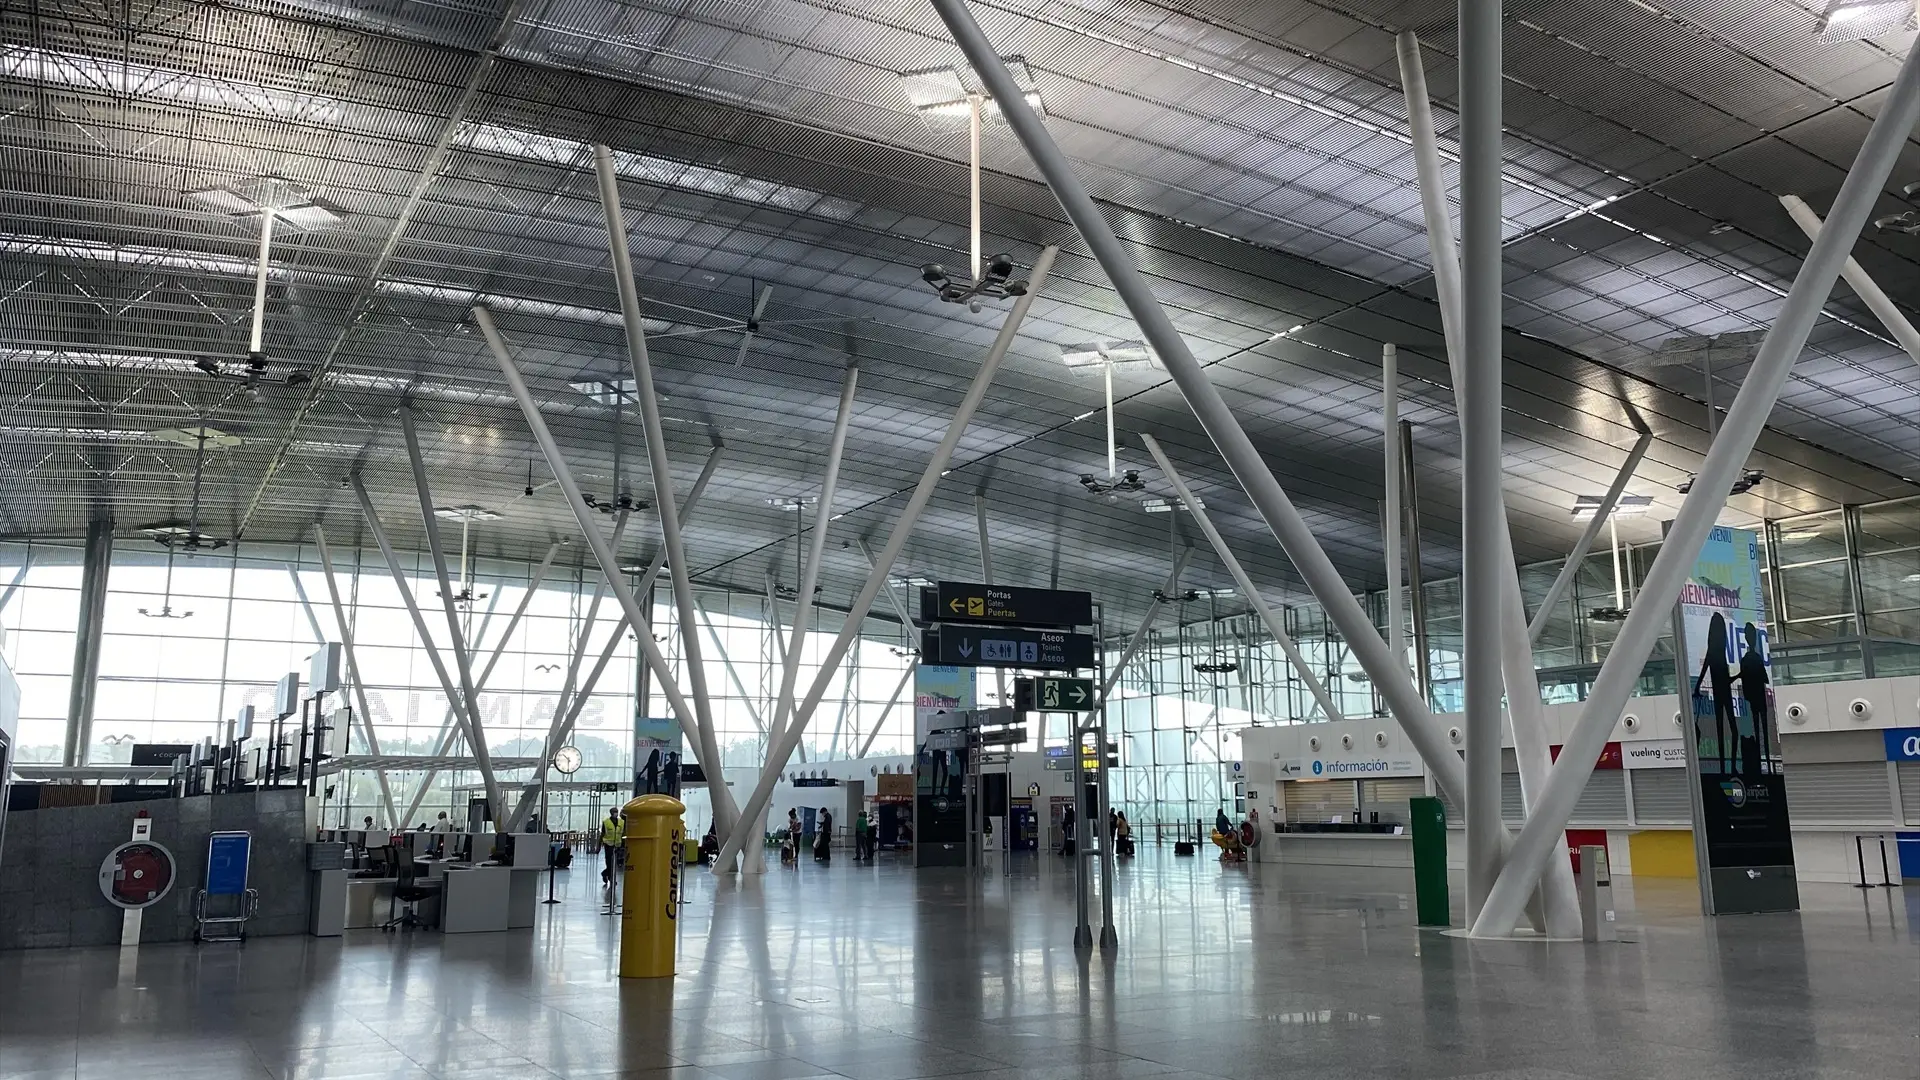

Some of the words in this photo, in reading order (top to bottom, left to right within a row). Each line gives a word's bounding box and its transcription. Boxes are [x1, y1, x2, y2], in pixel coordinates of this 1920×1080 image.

[987, 590, 1012, 600] Portas
[987, 608, 1016, 618] Puertas
[1041, 633, 1065, 642] Aseos
[1041, 644, 1061, 652] Toilets
[1041, 653, 1065, 663] Aseos
[1630, 747, 1661, 759] vueling
[1326, 759, 1389, 773] información
[665, 828, 680, 920] Correos
